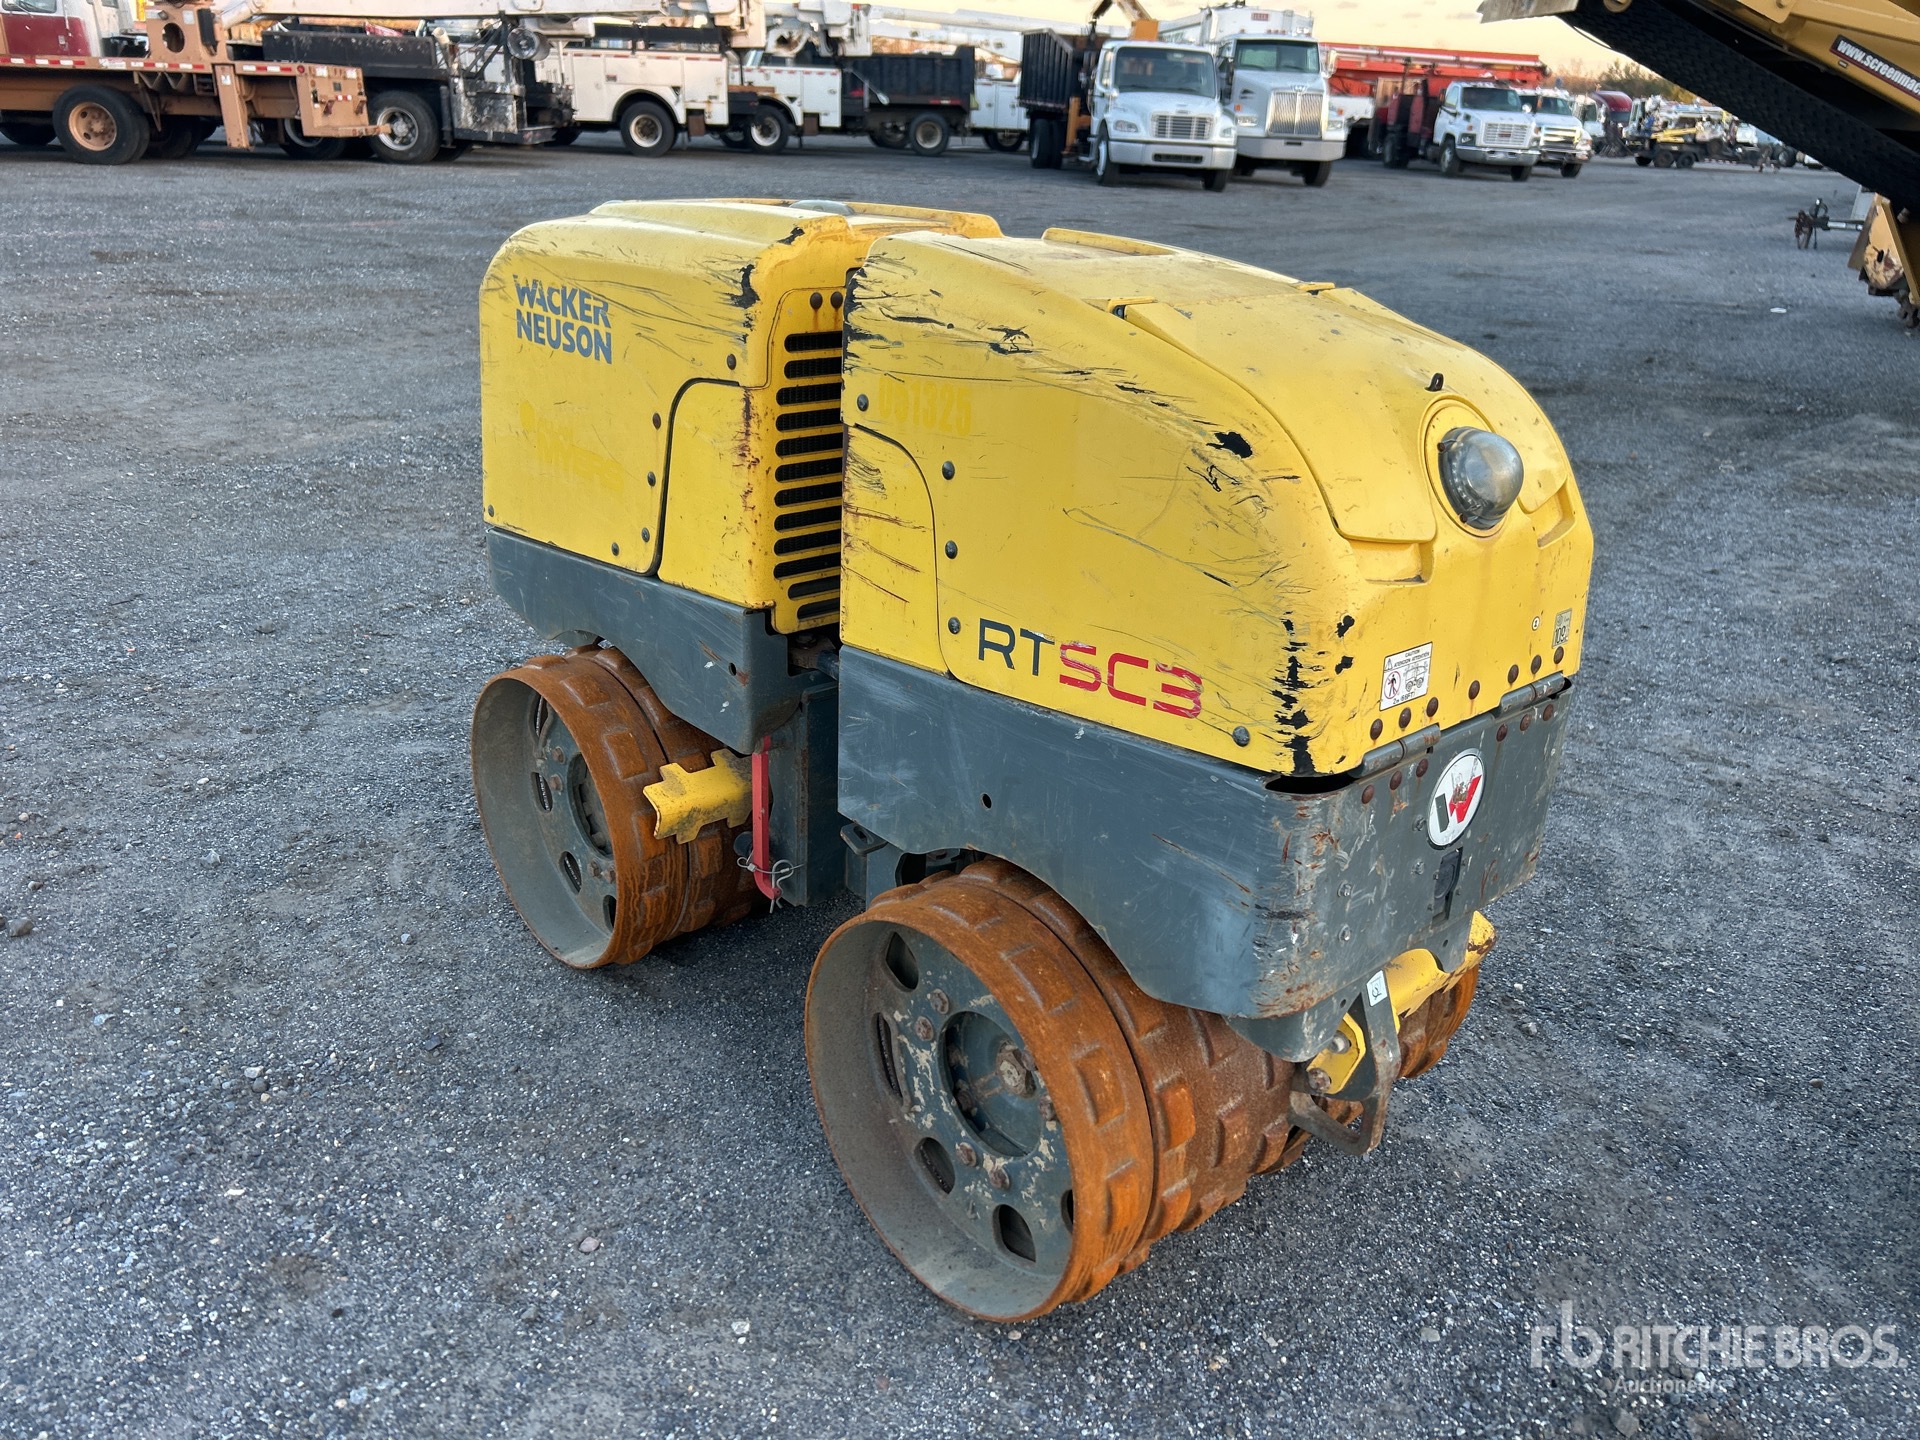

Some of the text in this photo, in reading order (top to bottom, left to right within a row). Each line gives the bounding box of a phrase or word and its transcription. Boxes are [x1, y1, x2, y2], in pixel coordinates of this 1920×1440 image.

[513, 274, 612, 328] WACKER
[516, 308, 612, 364] NEUSON
[979, 618, 1204, 719] RTSC3
